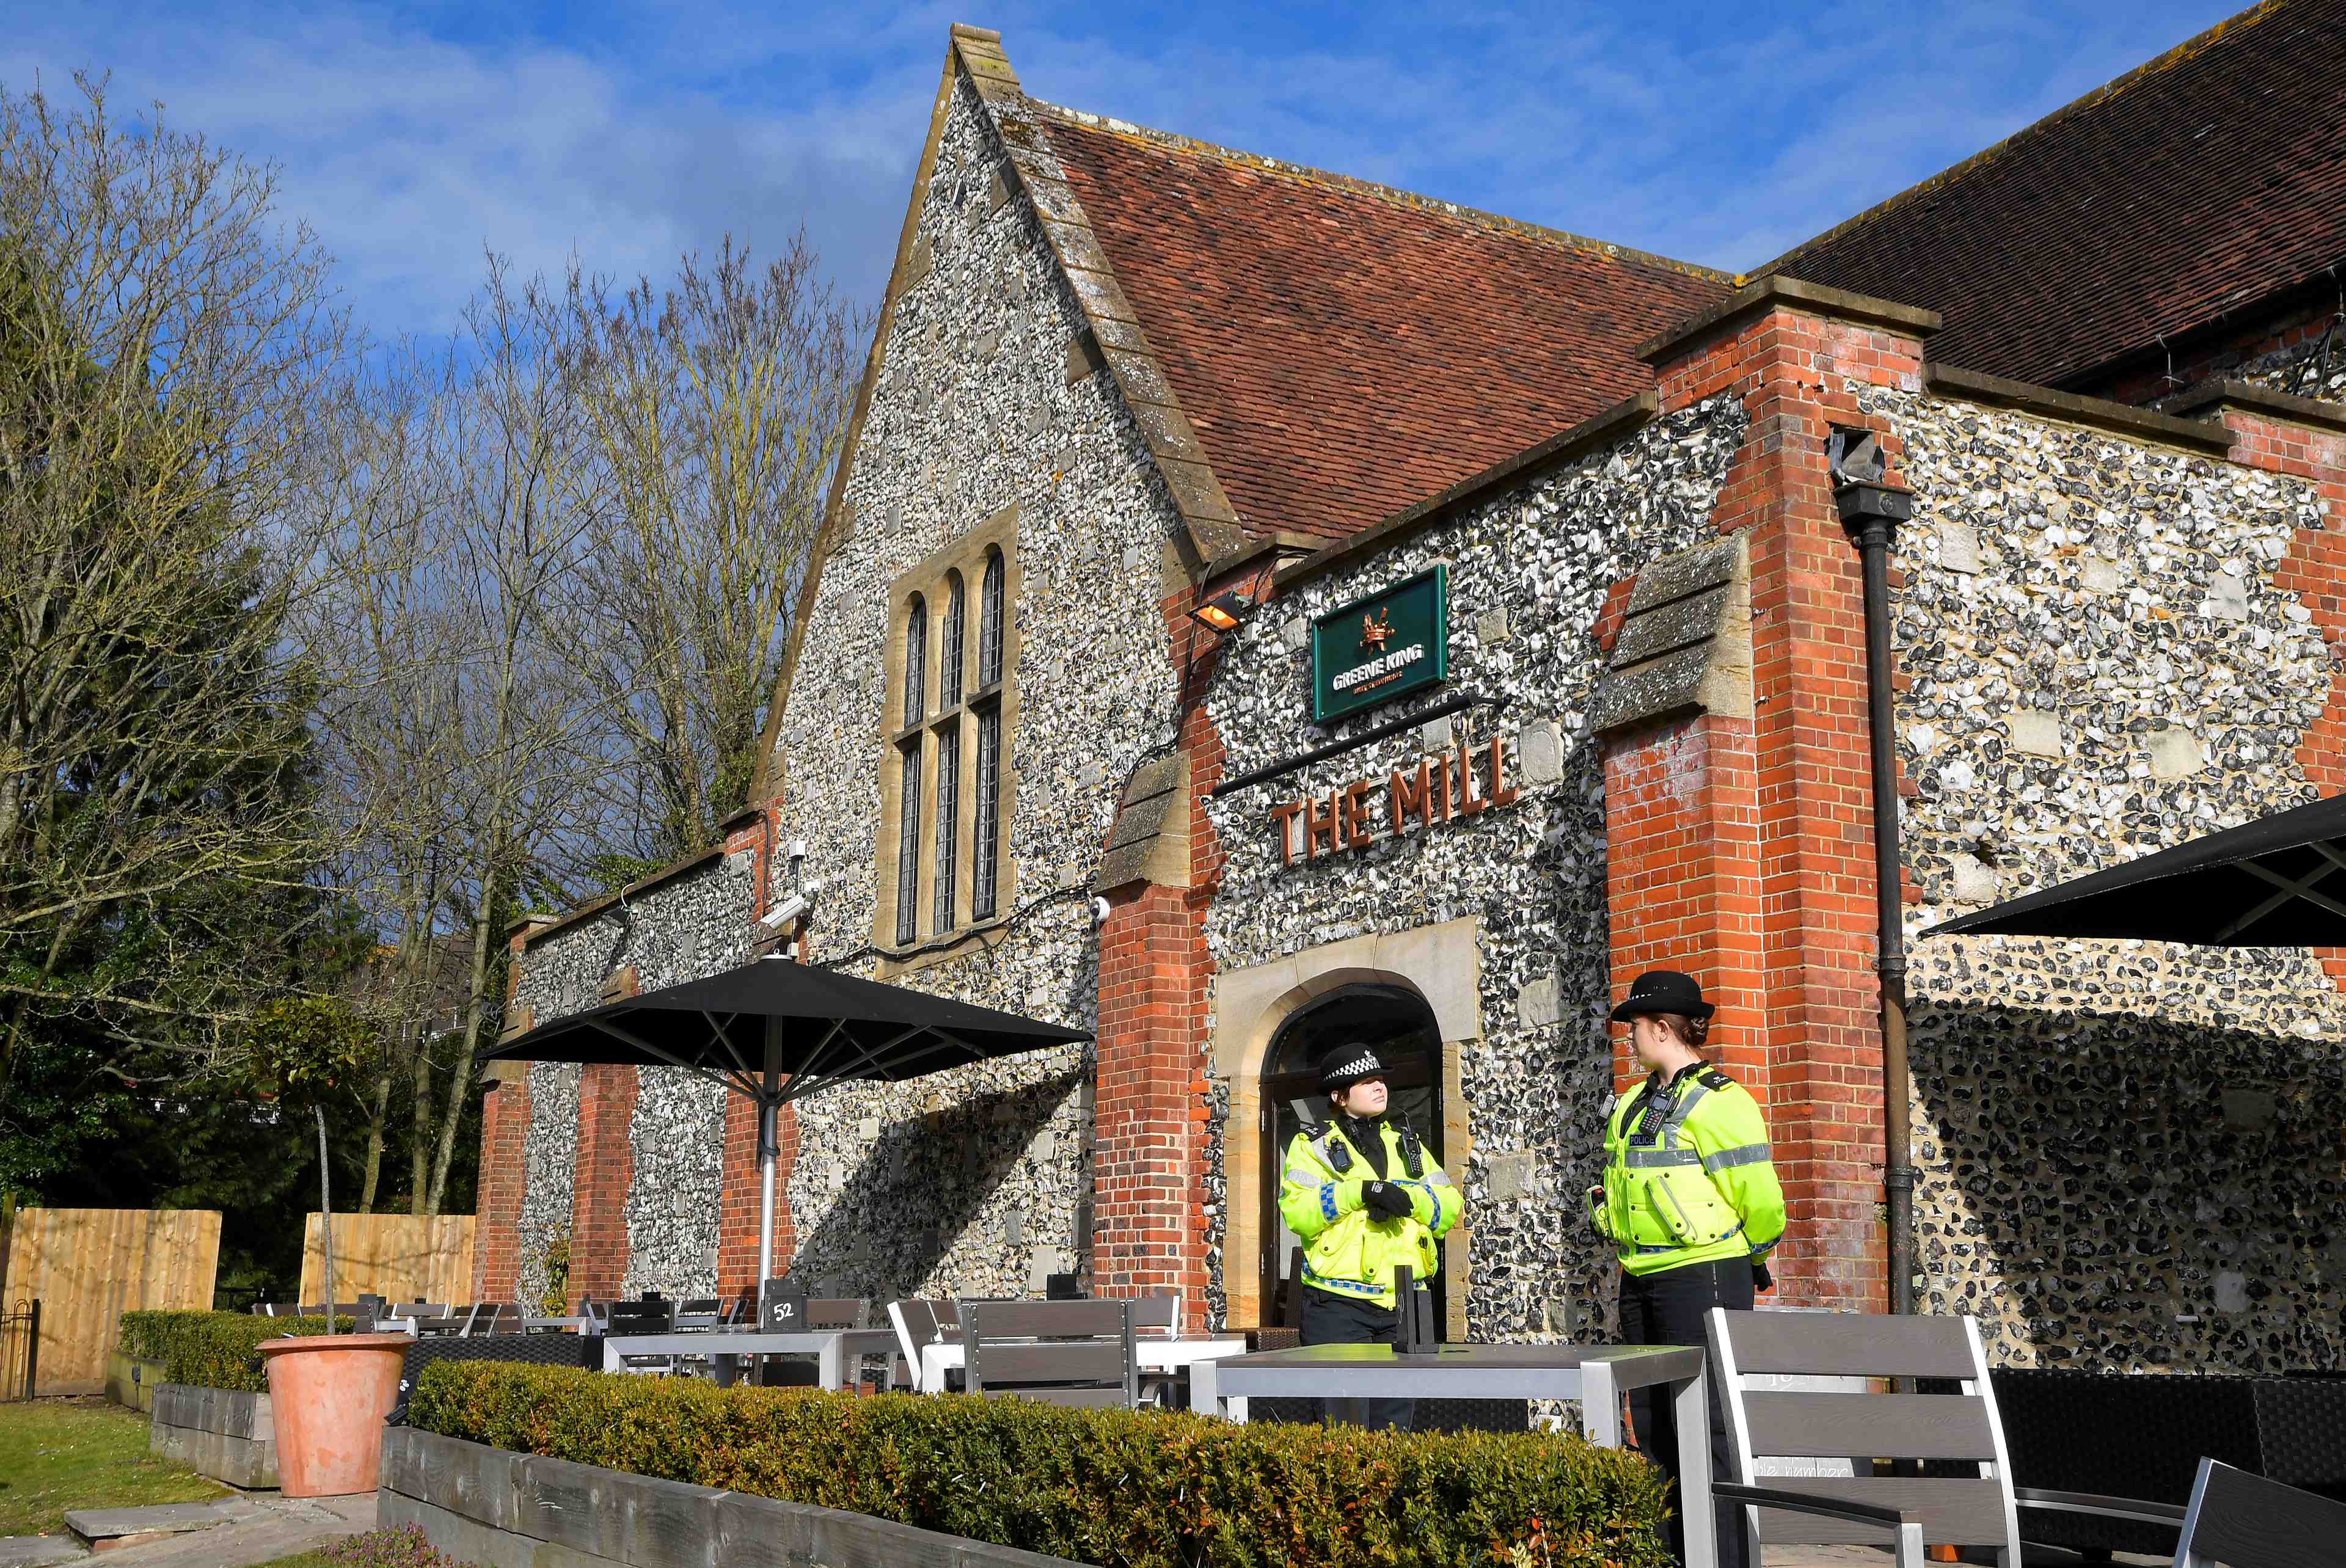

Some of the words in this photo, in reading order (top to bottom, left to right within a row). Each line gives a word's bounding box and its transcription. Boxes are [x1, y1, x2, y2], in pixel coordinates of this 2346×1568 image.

[1332, 658, 1384, 690] GREENE
[1386, 644, 1425, 671] KING
[1271, 781, 1372, 865] THE
[1390, 737, 1519, 836] MILL
[1631, 1136, 1655, 1144] POLICE
[773, 1302, 794, 1322] 52
[1785, 1462, 1848, 1477] number
